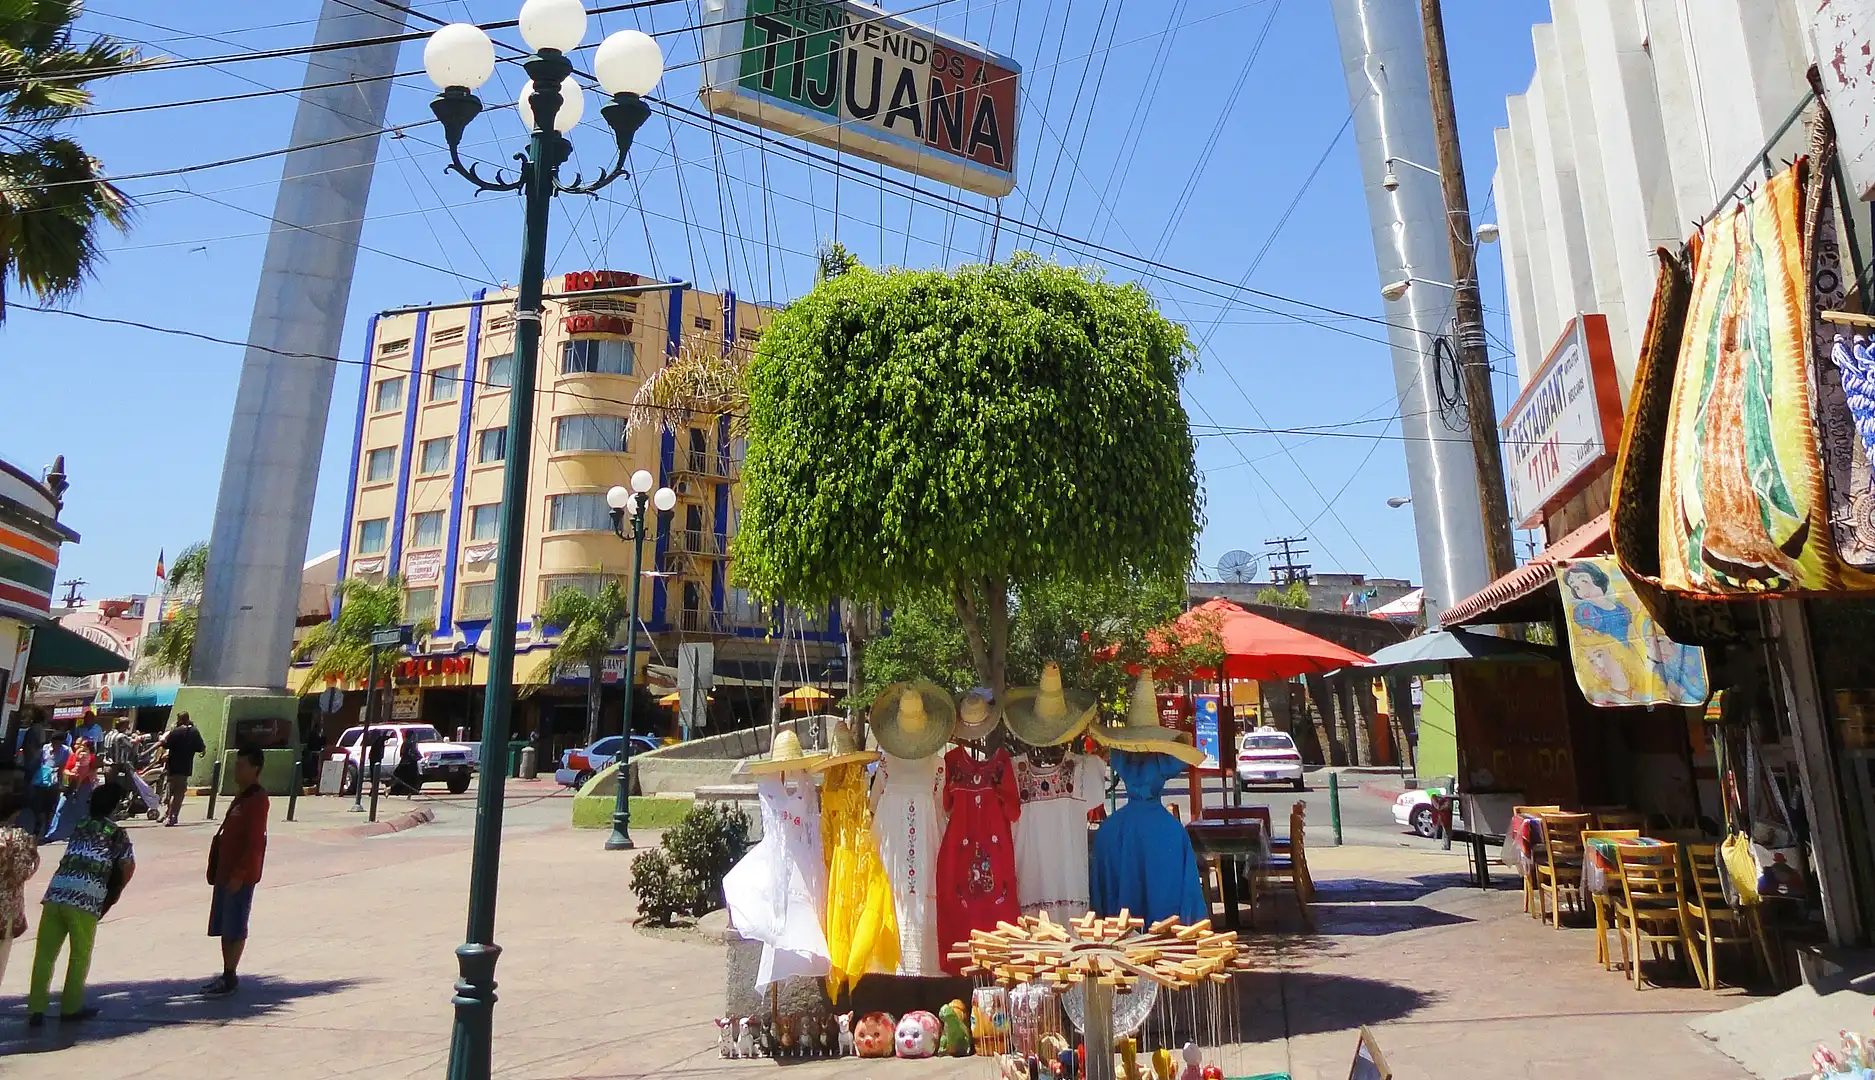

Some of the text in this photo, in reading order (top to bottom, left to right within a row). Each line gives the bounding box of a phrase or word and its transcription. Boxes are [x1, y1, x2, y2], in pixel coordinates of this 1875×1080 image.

[753, 13, 1005, 167] TIJUANA
[774, 0, 990, 90] BIENVENIDOS A
[1512, 363, 1567, 466] RESTAURANT
